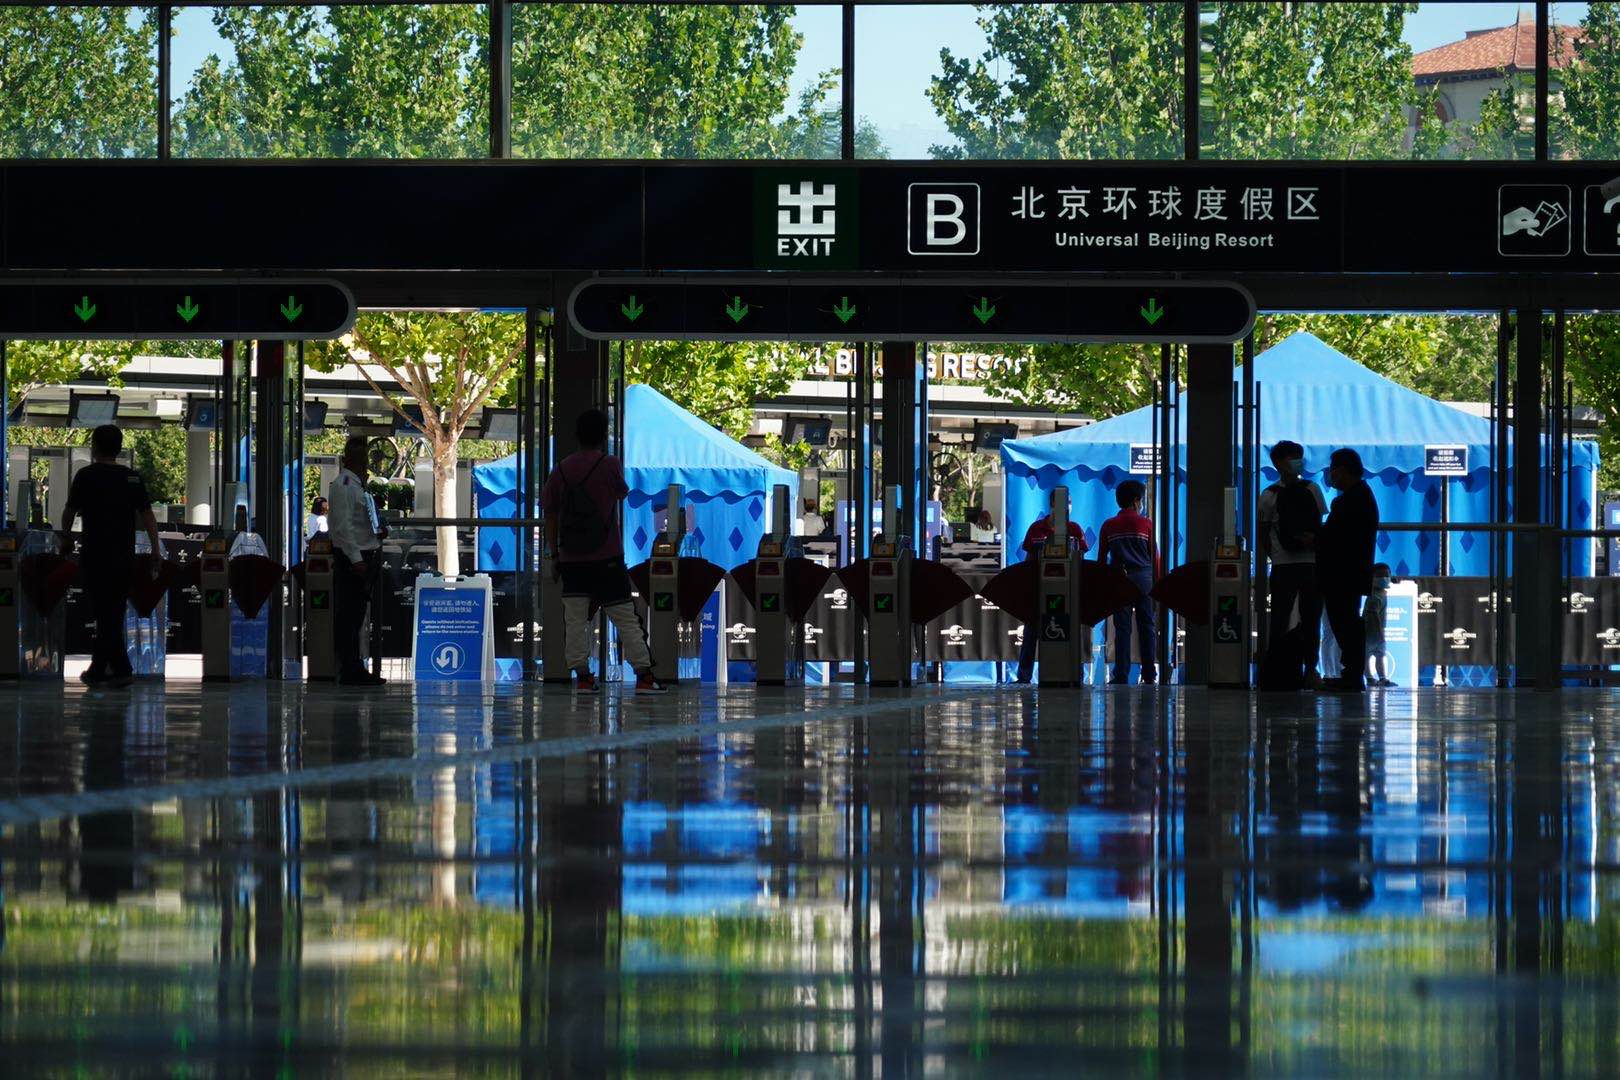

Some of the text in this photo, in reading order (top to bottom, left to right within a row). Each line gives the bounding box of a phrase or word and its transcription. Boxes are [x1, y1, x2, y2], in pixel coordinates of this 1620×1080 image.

[1010, 186, 1320, 221] 北京环球度假区
[926, 193, 967, 246] B
[777, 237, 836, 257] EXIT
[1055, 232, 1274, 251] Universal Beijing Resort
